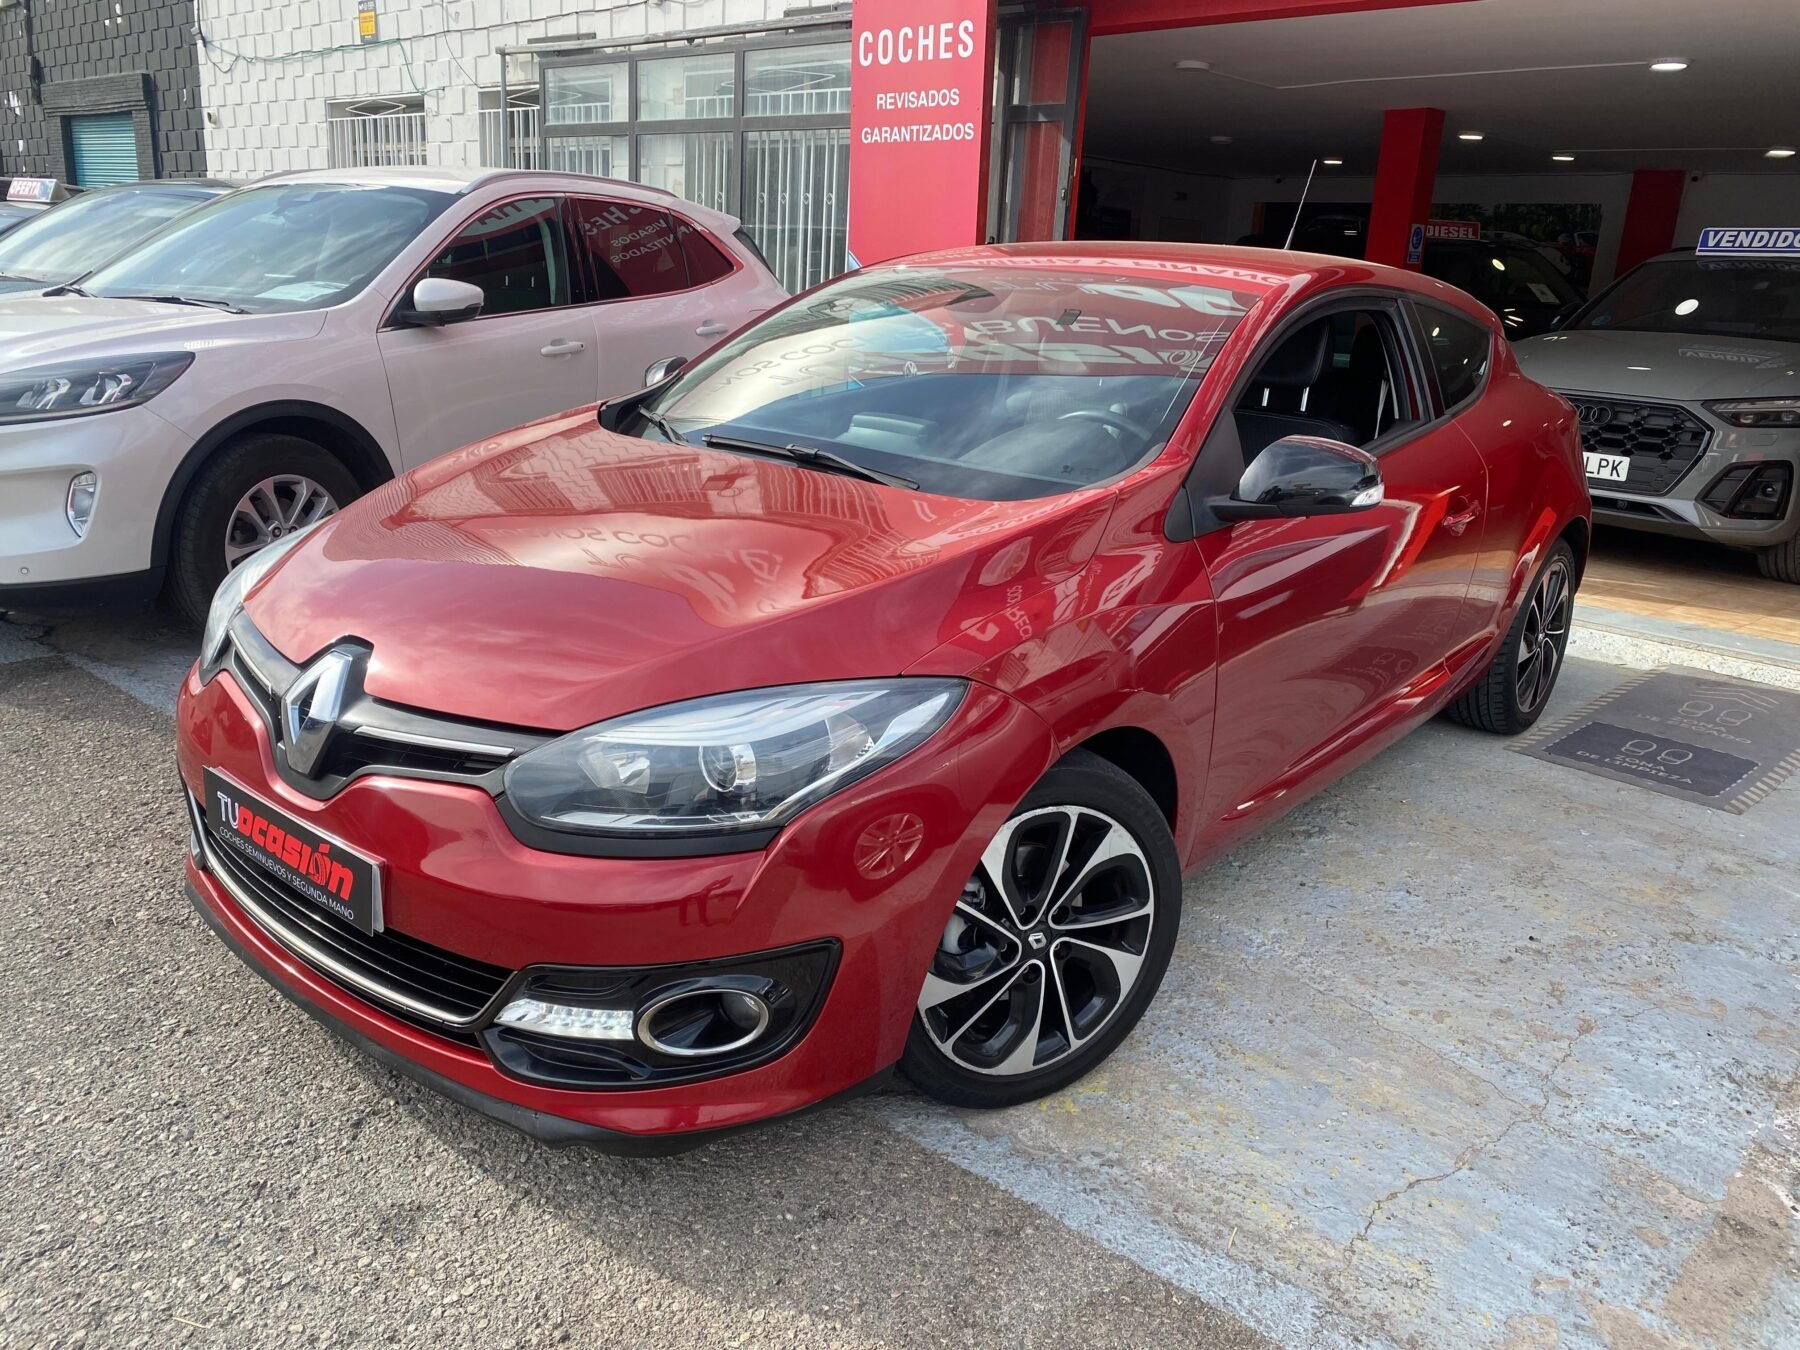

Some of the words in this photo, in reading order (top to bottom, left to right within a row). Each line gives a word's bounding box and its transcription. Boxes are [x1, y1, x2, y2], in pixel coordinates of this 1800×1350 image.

[858, 19, 974, 67] COCHES
[876, 88, 960, 110] REVISADOS
[861, 122, 975, 144] GARANTIZADOS
[1425, 224, 1477, 239] DIESEL
[1585, 456, 1624, 478] LPK
[1576, 750, 1601, 759] DE
[1604, 758, 1693, 784] LIMPIEZA
[1614, 754, 1666, 771] ZONA
[219, 826, 245, 850] COCHES
[244, 843, 287, 878] SEMINUEVOS
[286, 871, 292, 881] Y
[292, 875, 328, 905] SEGUNDA
[328, 898, 354, 920] MANO
